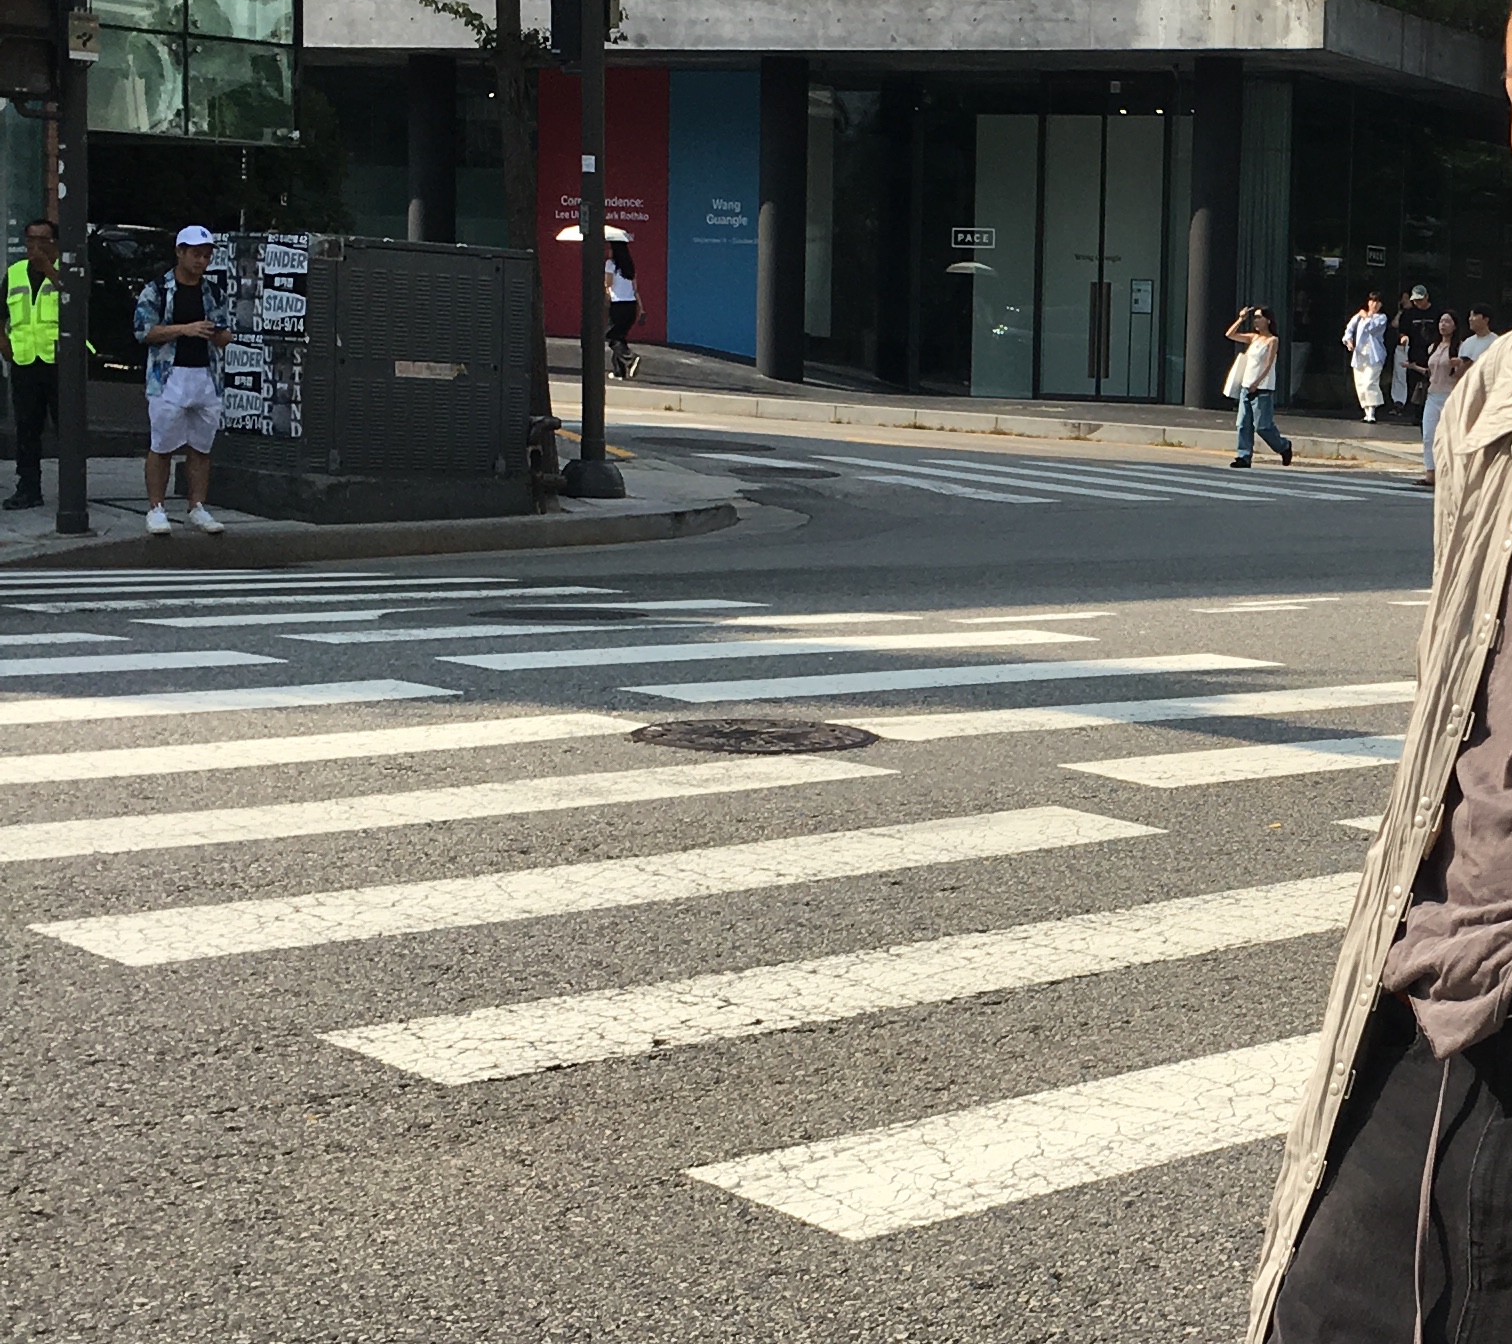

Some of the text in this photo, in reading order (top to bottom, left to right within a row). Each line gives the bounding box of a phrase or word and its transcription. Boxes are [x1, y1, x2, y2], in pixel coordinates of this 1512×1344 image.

[560, 194, 644, 208] Corrndence:
[712, 198, 741, 212] Wang
[555, 209, 570, 220] Lee
[620, 210, 650, 222] Rothko
[706, 214, 748, 227] Guangle
[957, 233, 990, 244] PACE
[265, 250, 306, 270] UNDER
[264, 294, 305, 314] STAND
[225, 349, 262, 368] UNDER
[225, 393, 261, 411] STAND
